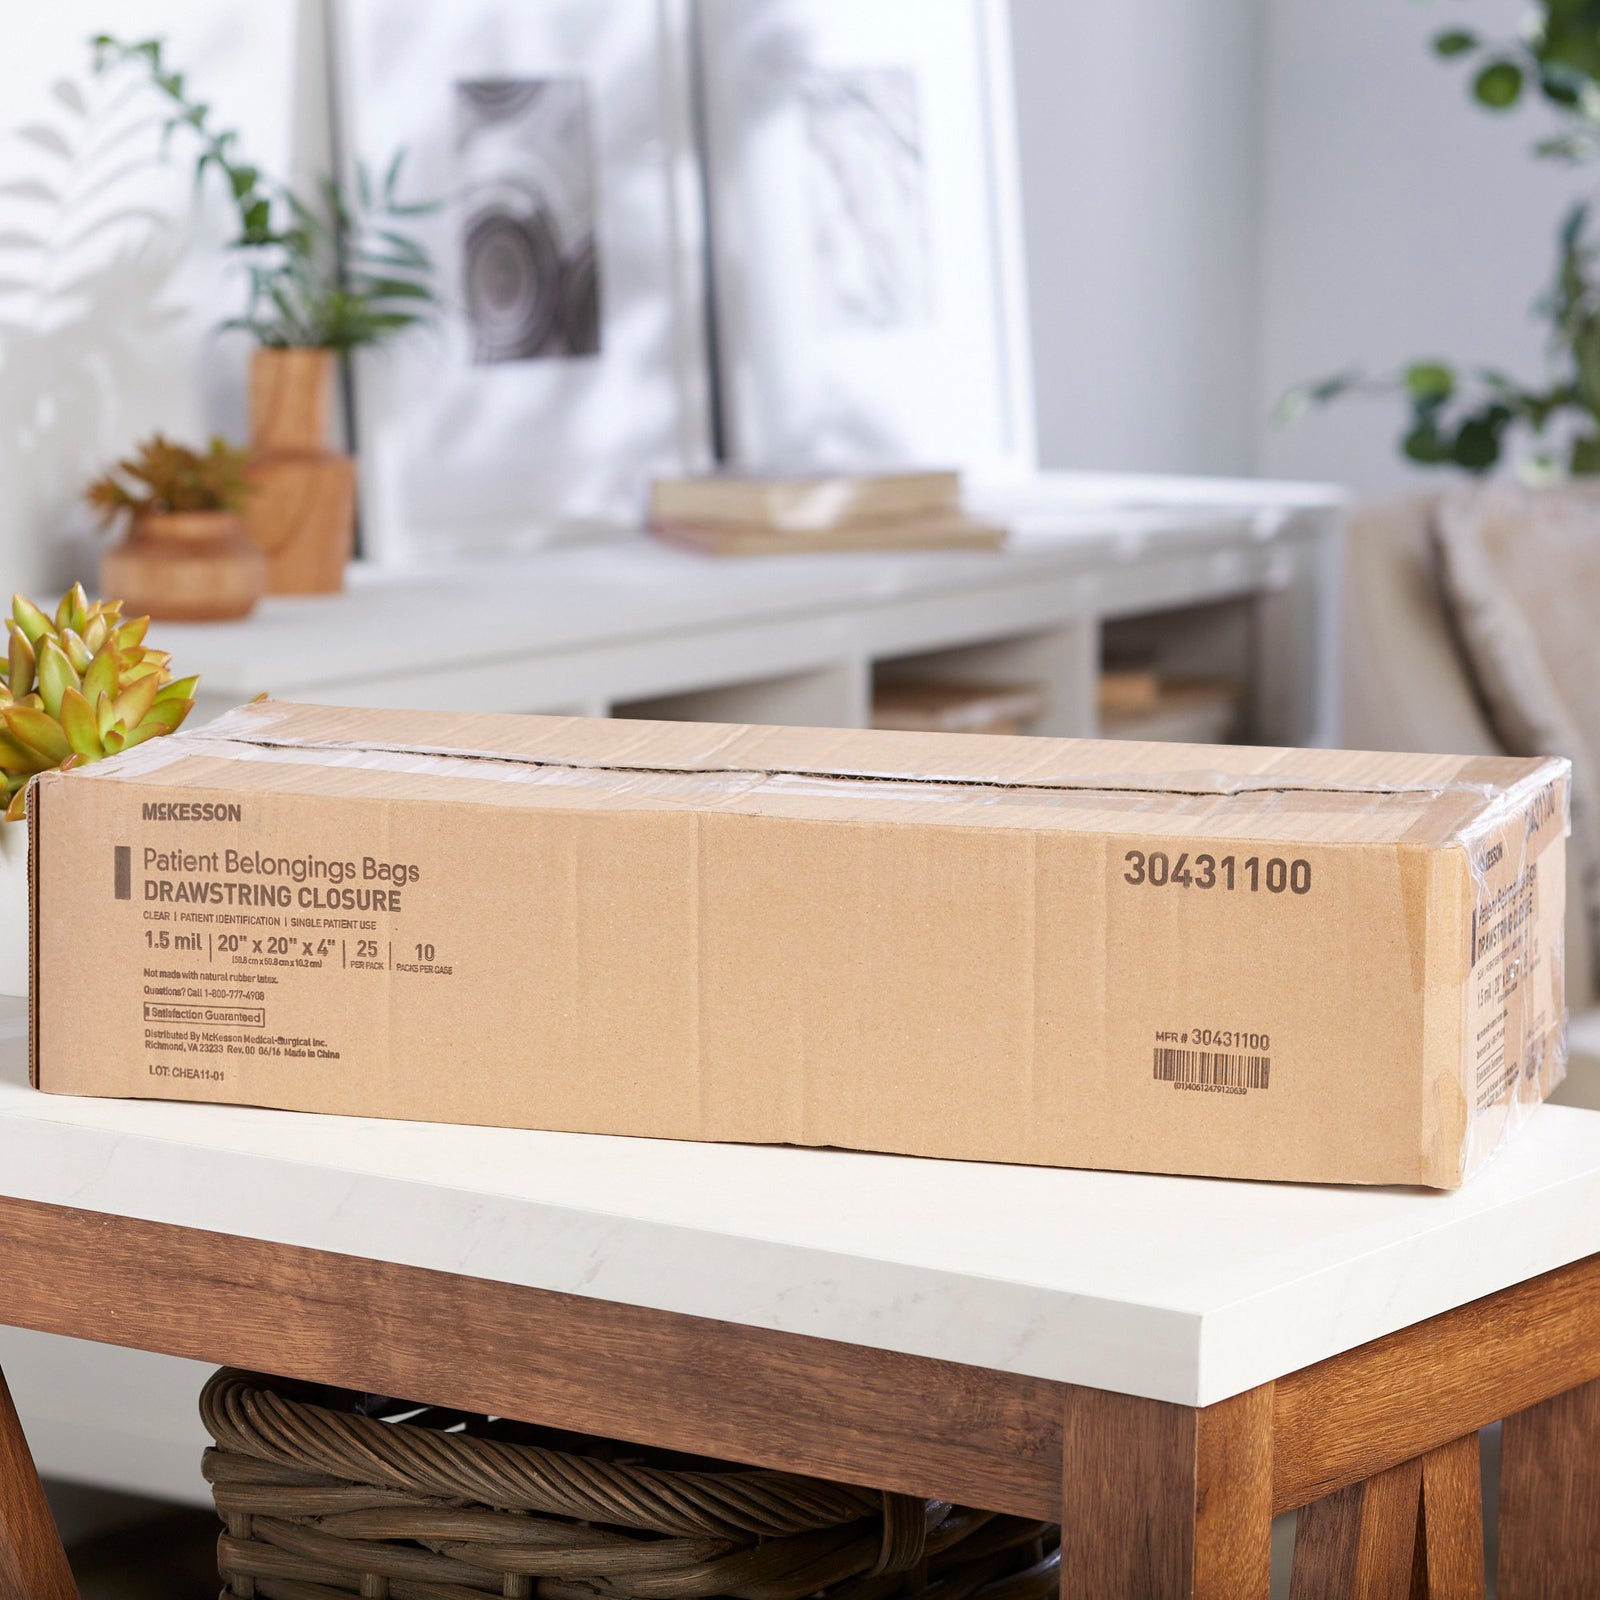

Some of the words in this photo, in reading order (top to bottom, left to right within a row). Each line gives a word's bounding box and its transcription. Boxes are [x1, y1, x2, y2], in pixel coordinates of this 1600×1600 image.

[143, 847, 219, 873] Patient
[225, 849, 356, 884] Belongings
[362, 856, 420, 887] Bags
[1124, 850, 1312, 895] 30431100
[144, 880, 292, 908] DRAWSTRING
[298, 886, 402, 912] CLOSURE
[143, 911, 170, 921] CLEAR
[180, 912, 214, 923] PATIENT
[215, 914, 281, 926] IDENTIFICATION
[290, 917, 322, 928] SINGLE
[323, 919, 358, 929] PATIENT
[360, 920, 377, 930] USE
[145, 930, 170, 949] 1.5
[174, 933, 202, 951] mil
[218, 934, 247, 952] 20"
[252, 940, 263, 954] x
[267, 936, 297, 955] 20"
[302, 942, 313, 956] x
[316, 938, 336, 957] 4"
[356, 939, 378, 958] 25
[414, 943, 435, 962] 10
[279, 959, 289, 967] cm
[350, 960, 365, 970] PER
[366, 962, 385, 971] PACK
[396, 963, 419, 973] PACKS
[420, 965, 434, 974] PER
[434, 965, 453, 976] CASE
[143, 968, 158, 978] Not
[159, 970, 181, 979] made
[182, 970, 198, 980] with
[200, 971, 228, 982] natural
[229, 973, 256, 983] rubber
[256, 974, 279, 985] latex.
[143, 985, 185, 997] Questions?
[187, 987, 203, 998] Call
[204, 988, 265, 1001] 1-800-777-4908
[151, 1007, 203, 1019] Satisfaction
[204, 1010, 261, 1023] Guaranteed
[144, 1029, 188, 1041] Distributed
[190, 1031, 201, 1042] By
[202, 1032, 242, 1043] McKesson
[244, 1034, 312, 1048] Medical-Surgical
[312, 1038, 328, 1048] Inc.
[1155, 1031, 1178, 1043] MFR
[1180, 1033, 1188, 1044] #
[1191, 1028, 1271, 1051] 30431100
[145, 1041, 187, 1053] Richmond,
[188, 1043, 198, 1052] VA
[199, 1044, 224, 1054] 23233
[258, 1047, 281, 1057] 06/16
[284, 1048, 306, 1058] Made
[307, 1049, 316, 1058] in
[316, 1049, 340, 1060] China
[149, 1064, 170, 1077] LOT:
[172, 1066, 225, 1082] CHEA11-01
